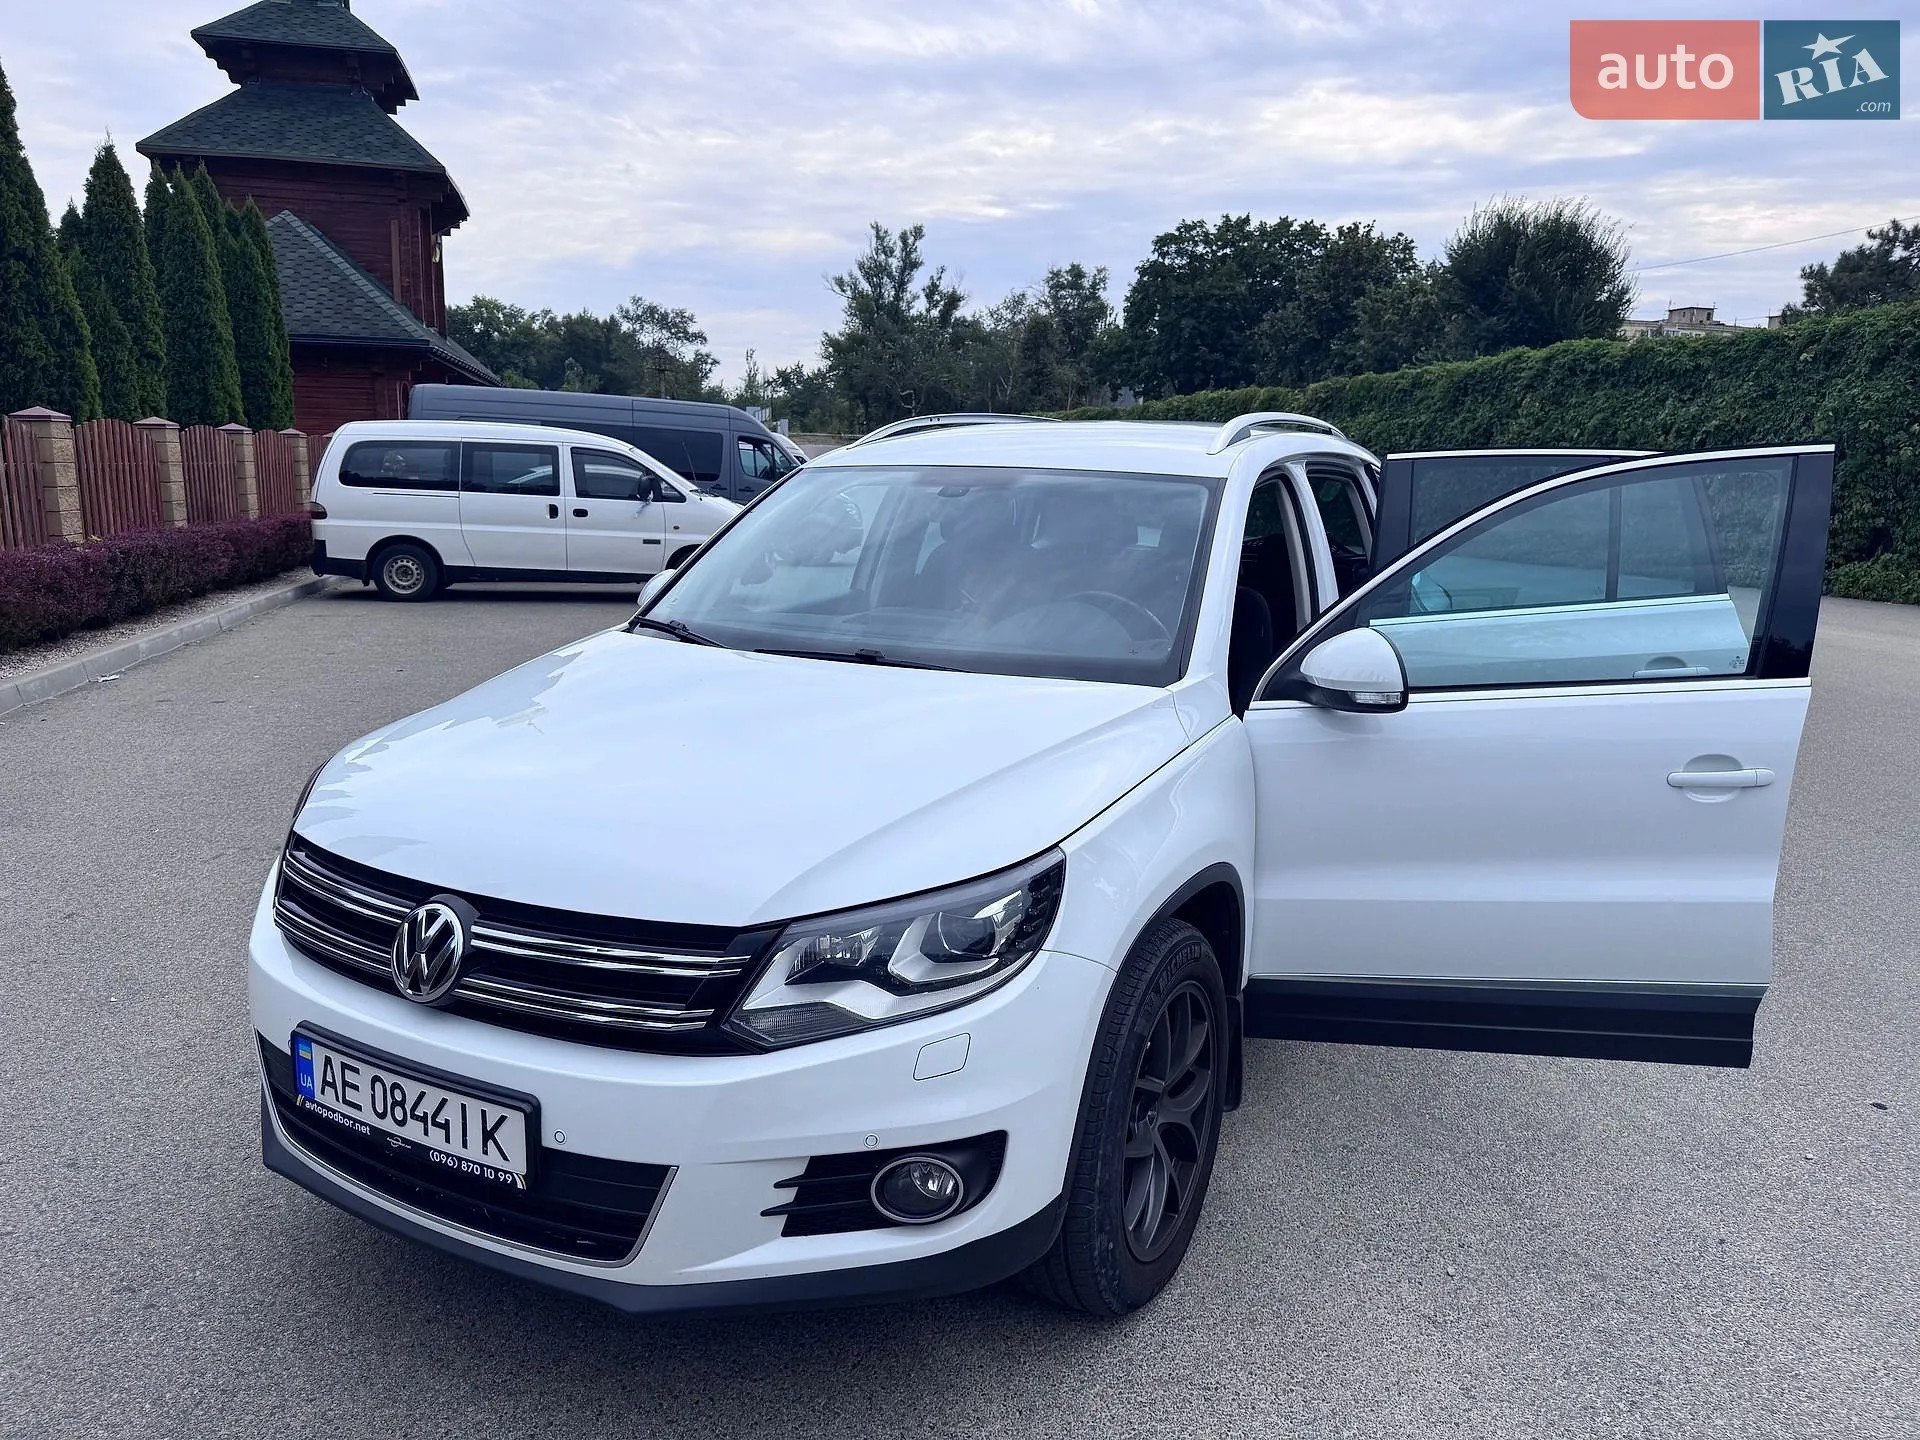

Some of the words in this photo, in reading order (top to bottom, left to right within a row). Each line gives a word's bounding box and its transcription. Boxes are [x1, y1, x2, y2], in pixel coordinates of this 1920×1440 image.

[300, 1072, 313, 1090] UA
[305, 1100, 371, 1135] avtopodbor.net
[429, 1150, 458, 1168] (096)
[461, 1161, 480, 1175] 870
[483, 1167, 495, 1179] 10
[498, 1172, 513, 1184] 99
